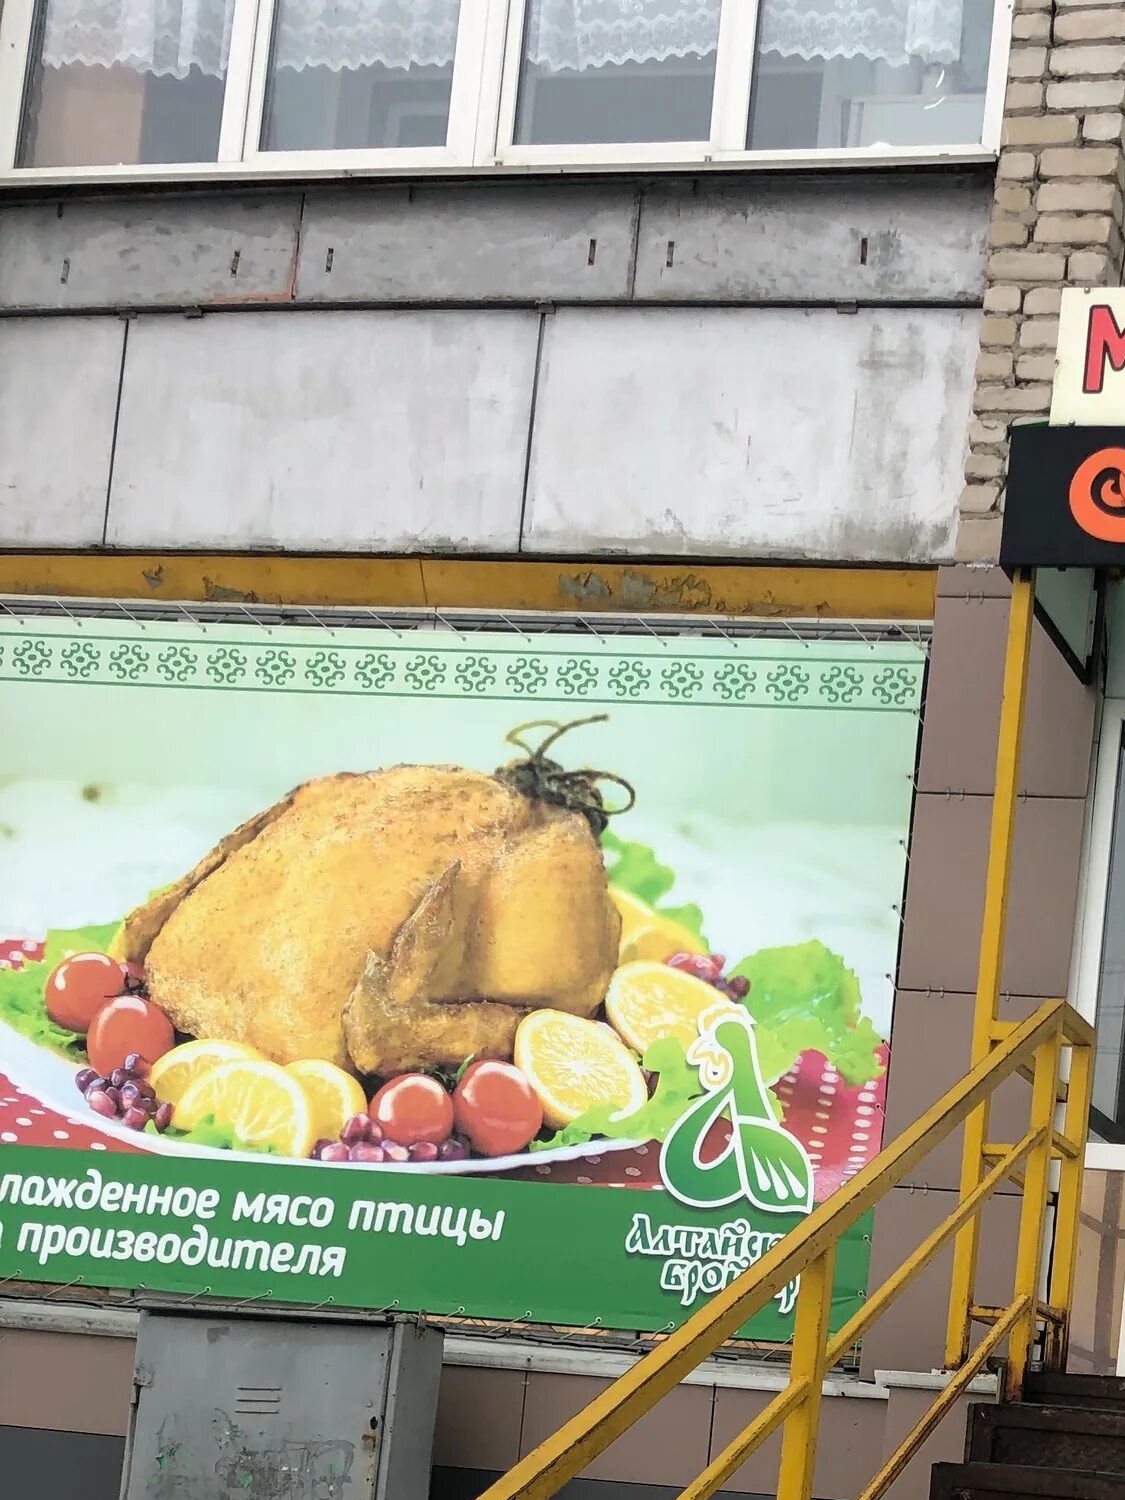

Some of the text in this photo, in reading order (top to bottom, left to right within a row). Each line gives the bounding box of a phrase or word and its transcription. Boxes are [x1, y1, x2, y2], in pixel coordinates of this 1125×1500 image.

[0, 1168, 505, 1247] лажденное мясо птицы
[16, 1221, 347, 1277] производителя
